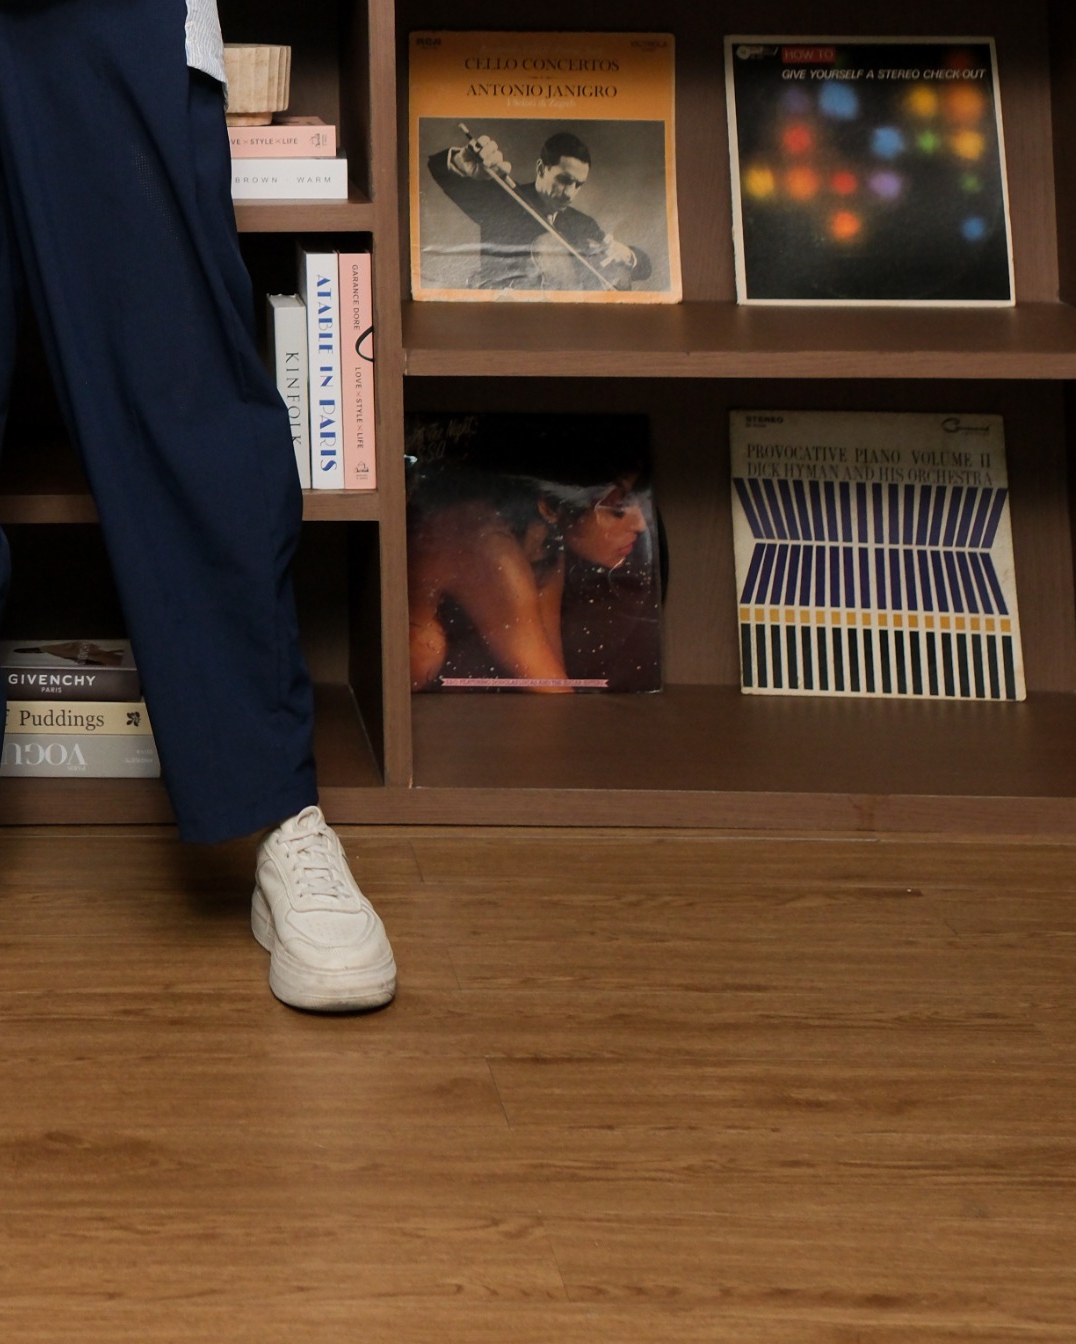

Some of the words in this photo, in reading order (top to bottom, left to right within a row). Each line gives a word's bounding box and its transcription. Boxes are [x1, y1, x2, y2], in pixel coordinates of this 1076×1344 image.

[464, 57, 518, 70] CELLO
[522, 57, 620, 71] CONCERTOS
[785, 48, 813, 60] HOW
[818, 47, 834, 59] TO
[782, 69, 806, 80] GIVE
[810, 69, 864, 80] YOURSELF
[866, 69, 874, 79] A
[877, 69, 920, 80] STEREO
[466, 84, 543, 96] ANTONIO
[546, 84, 617, 98] JANIGRO
[351, 265, 359, 305] GARANCE
[320, 366, 333, 387] IN
[319, 399, 337, 472] PARIS
[747, 443, 847, 463] PROVOCATIVE
[855, 447, 901, 464] PIANO
[911, 449, 973, 468] VOLUME
[980, 452, 991, 468] II
[747, 461, 780, 477] DICK
[784, 462, 838, 479] HYMAN
[843, 464, 875, 481] AND
[879, 466, 904, 482] HIS
[908, 467, 992, 485] ORCHESTRA
[8, 673, 96, 687] GIVENCHY
[19, 709, 104, 731] Puddings
